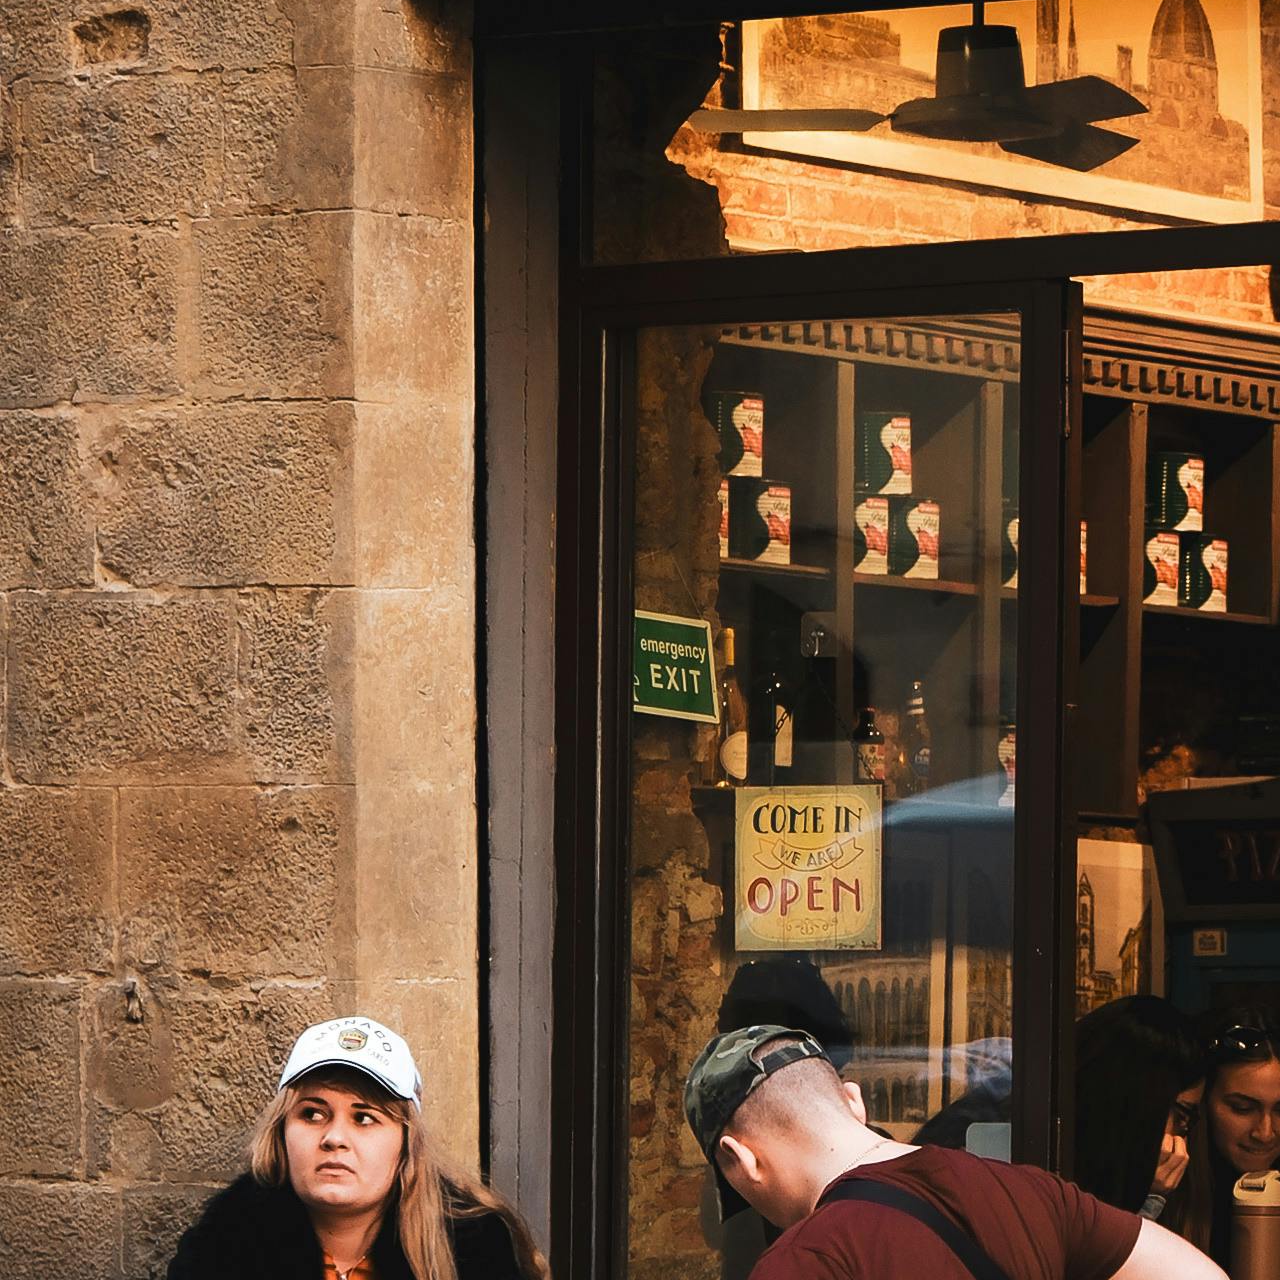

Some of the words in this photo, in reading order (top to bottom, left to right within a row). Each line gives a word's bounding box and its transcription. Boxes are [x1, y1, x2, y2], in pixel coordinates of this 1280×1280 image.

[640, 638, 706, 664] emergency
[650, 663, 701, 694] EXIT
[752, 802, 825, 834] COME
[834, 805, 863, 834] IN
[780, 845, 801, 866] WE
[806, 845, 836, 867] ARE
[747, 876, 862, 917] OPEN
